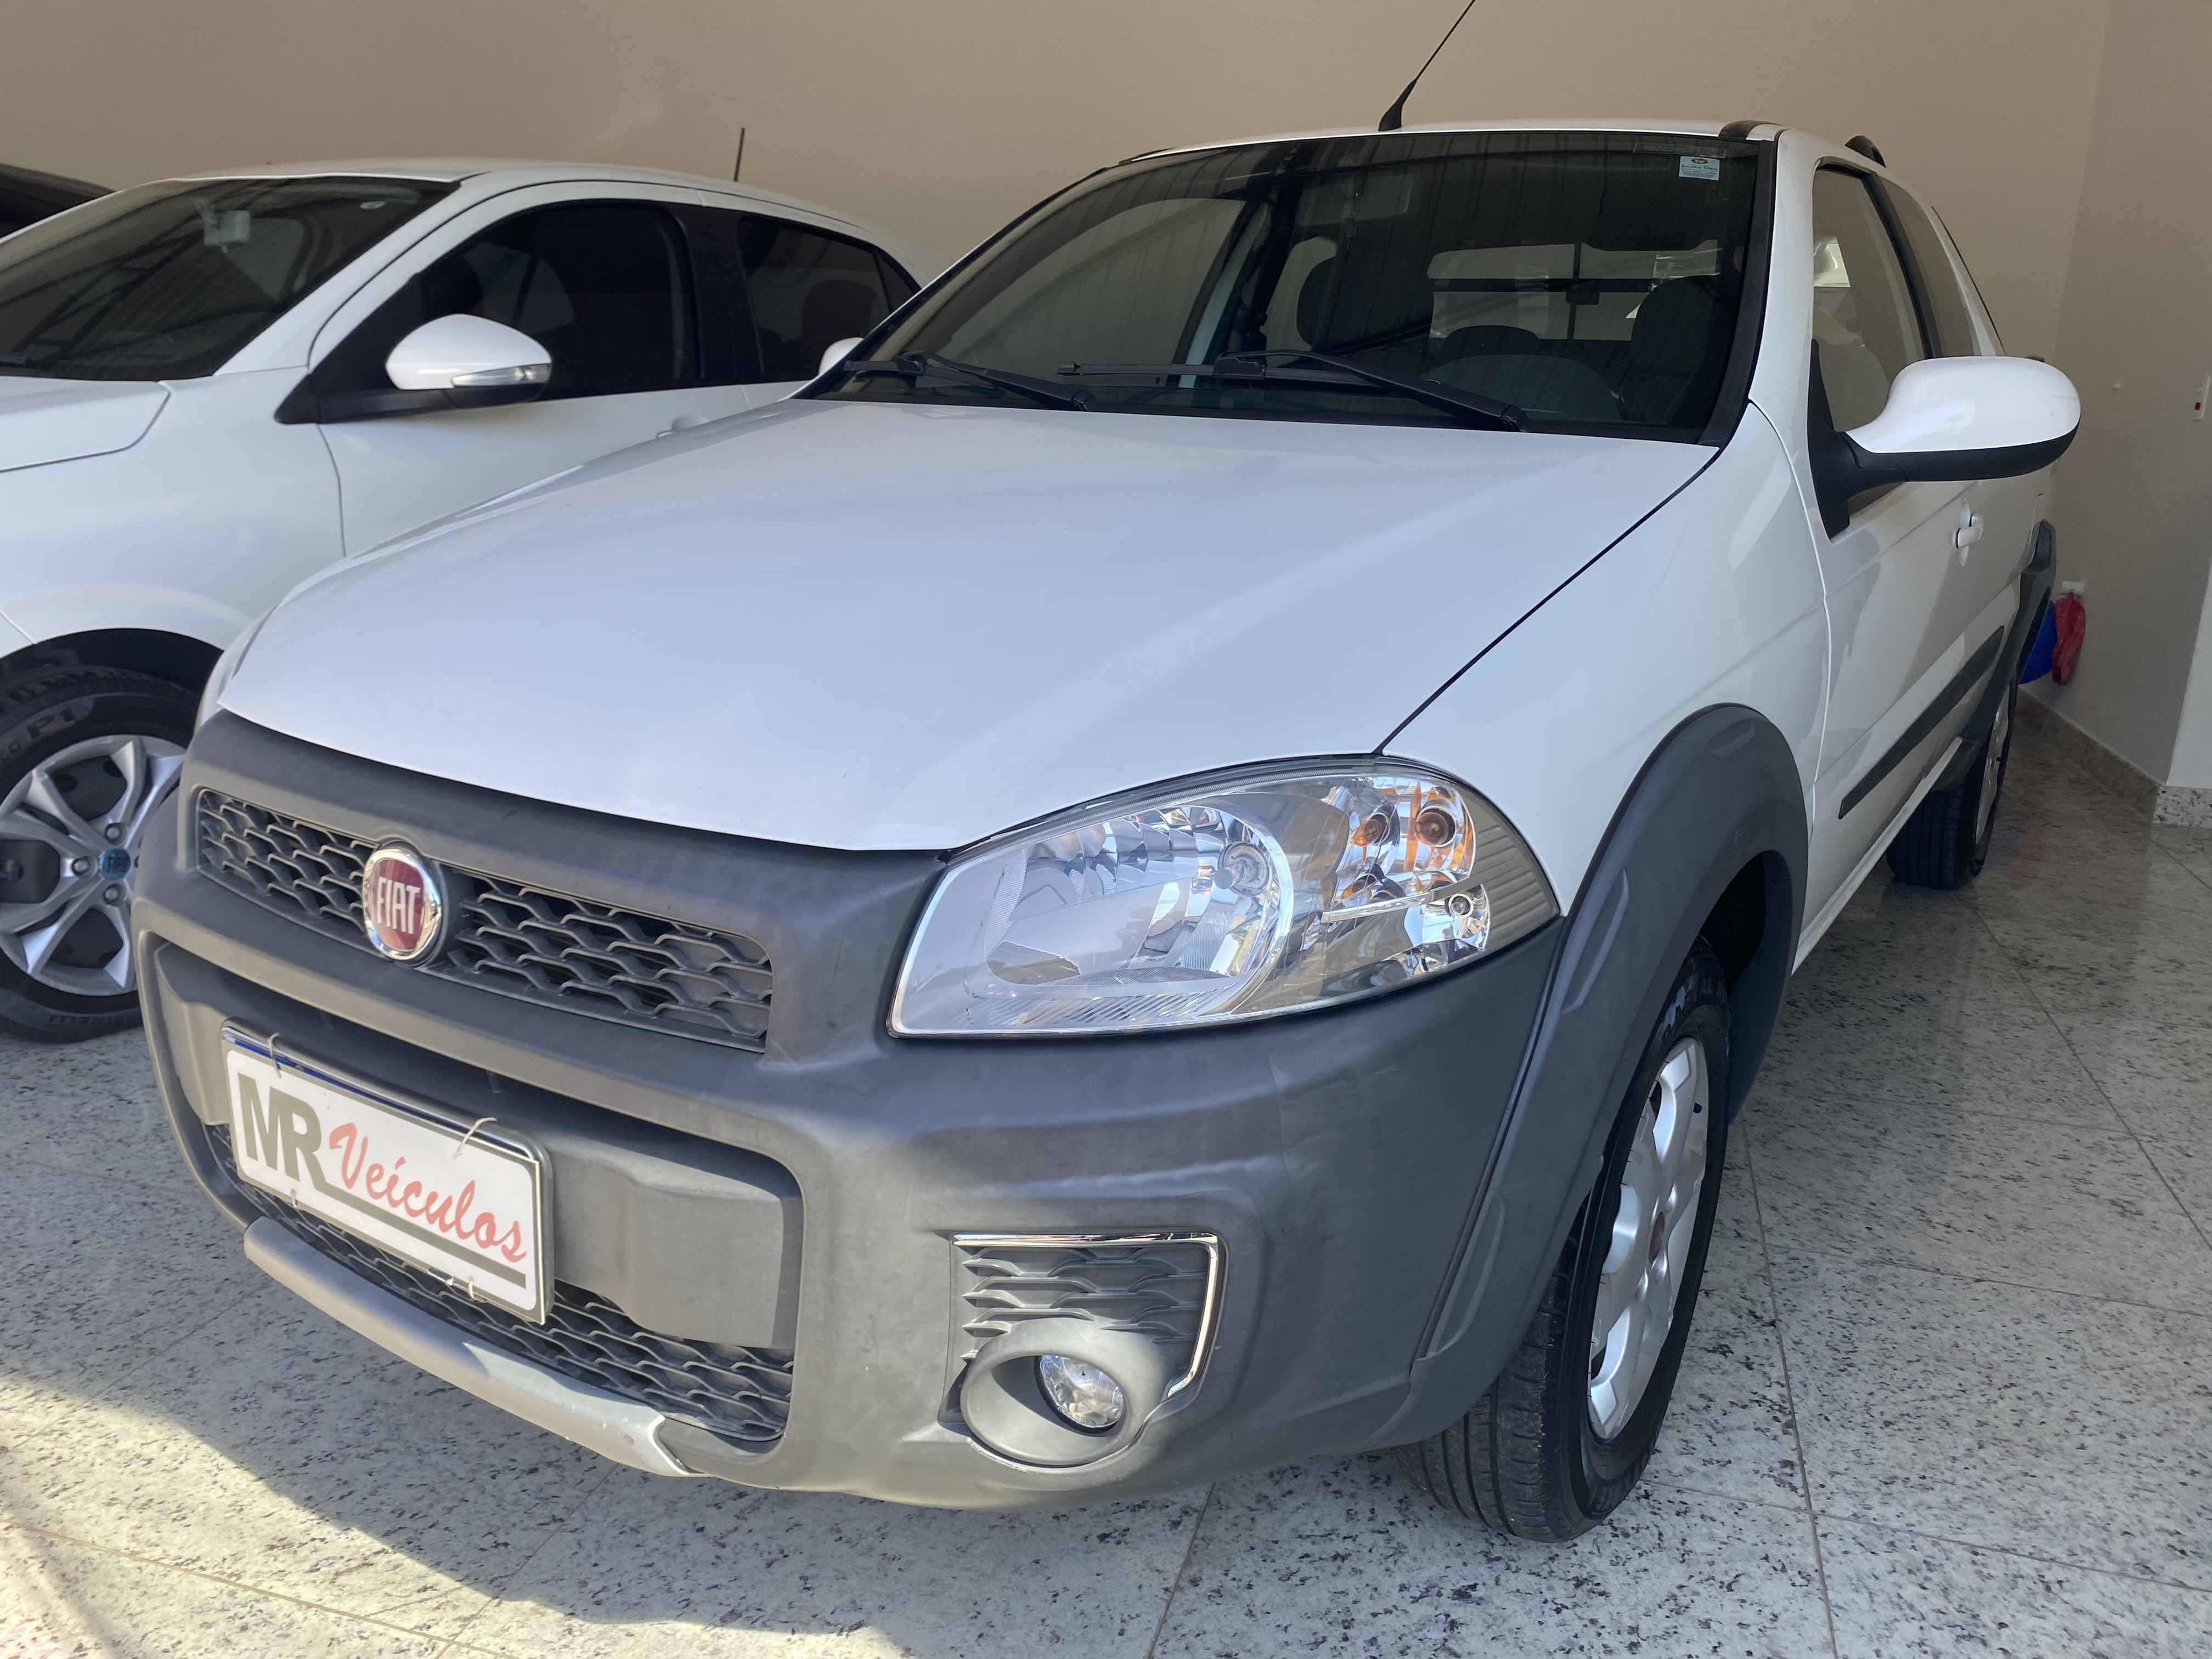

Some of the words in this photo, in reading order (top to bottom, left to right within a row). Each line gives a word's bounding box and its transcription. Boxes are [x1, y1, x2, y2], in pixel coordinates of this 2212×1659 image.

[376, 876, 421, 934] FIAT
[238, 1072, 328, 1192] MR
[329, 1122, 527, 1263] Veículos
